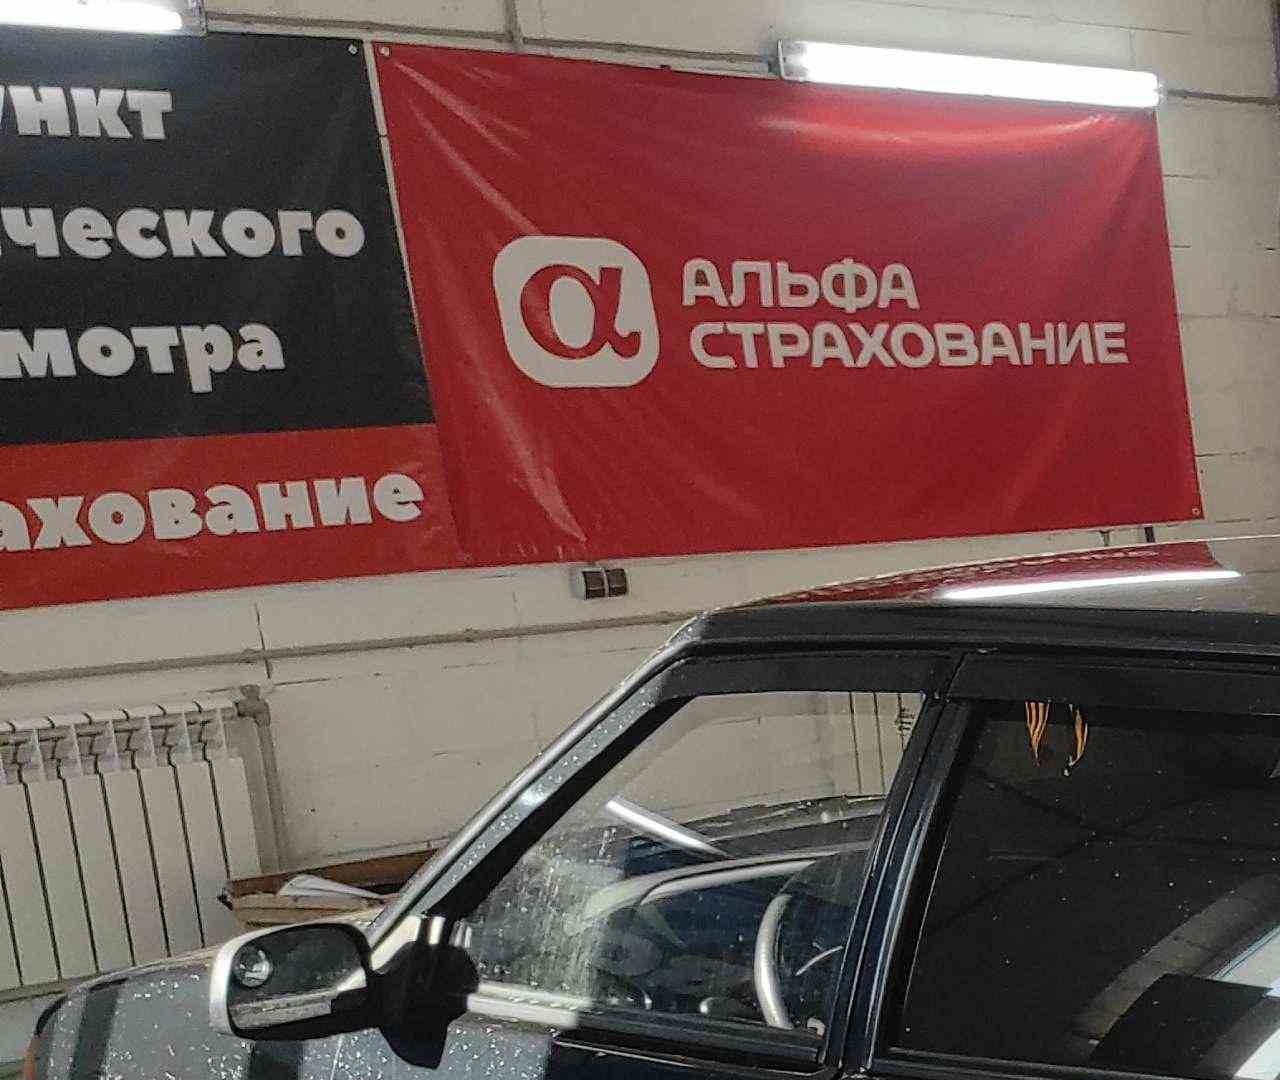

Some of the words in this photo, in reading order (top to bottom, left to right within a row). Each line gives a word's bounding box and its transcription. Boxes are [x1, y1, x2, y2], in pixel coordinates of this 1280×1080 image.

[0, 84, 173, 140] нкт
[682, 257, 921, 314] АЛЬФА
[689, 321, 1129, 369] СТРАХОВАНИЕ
